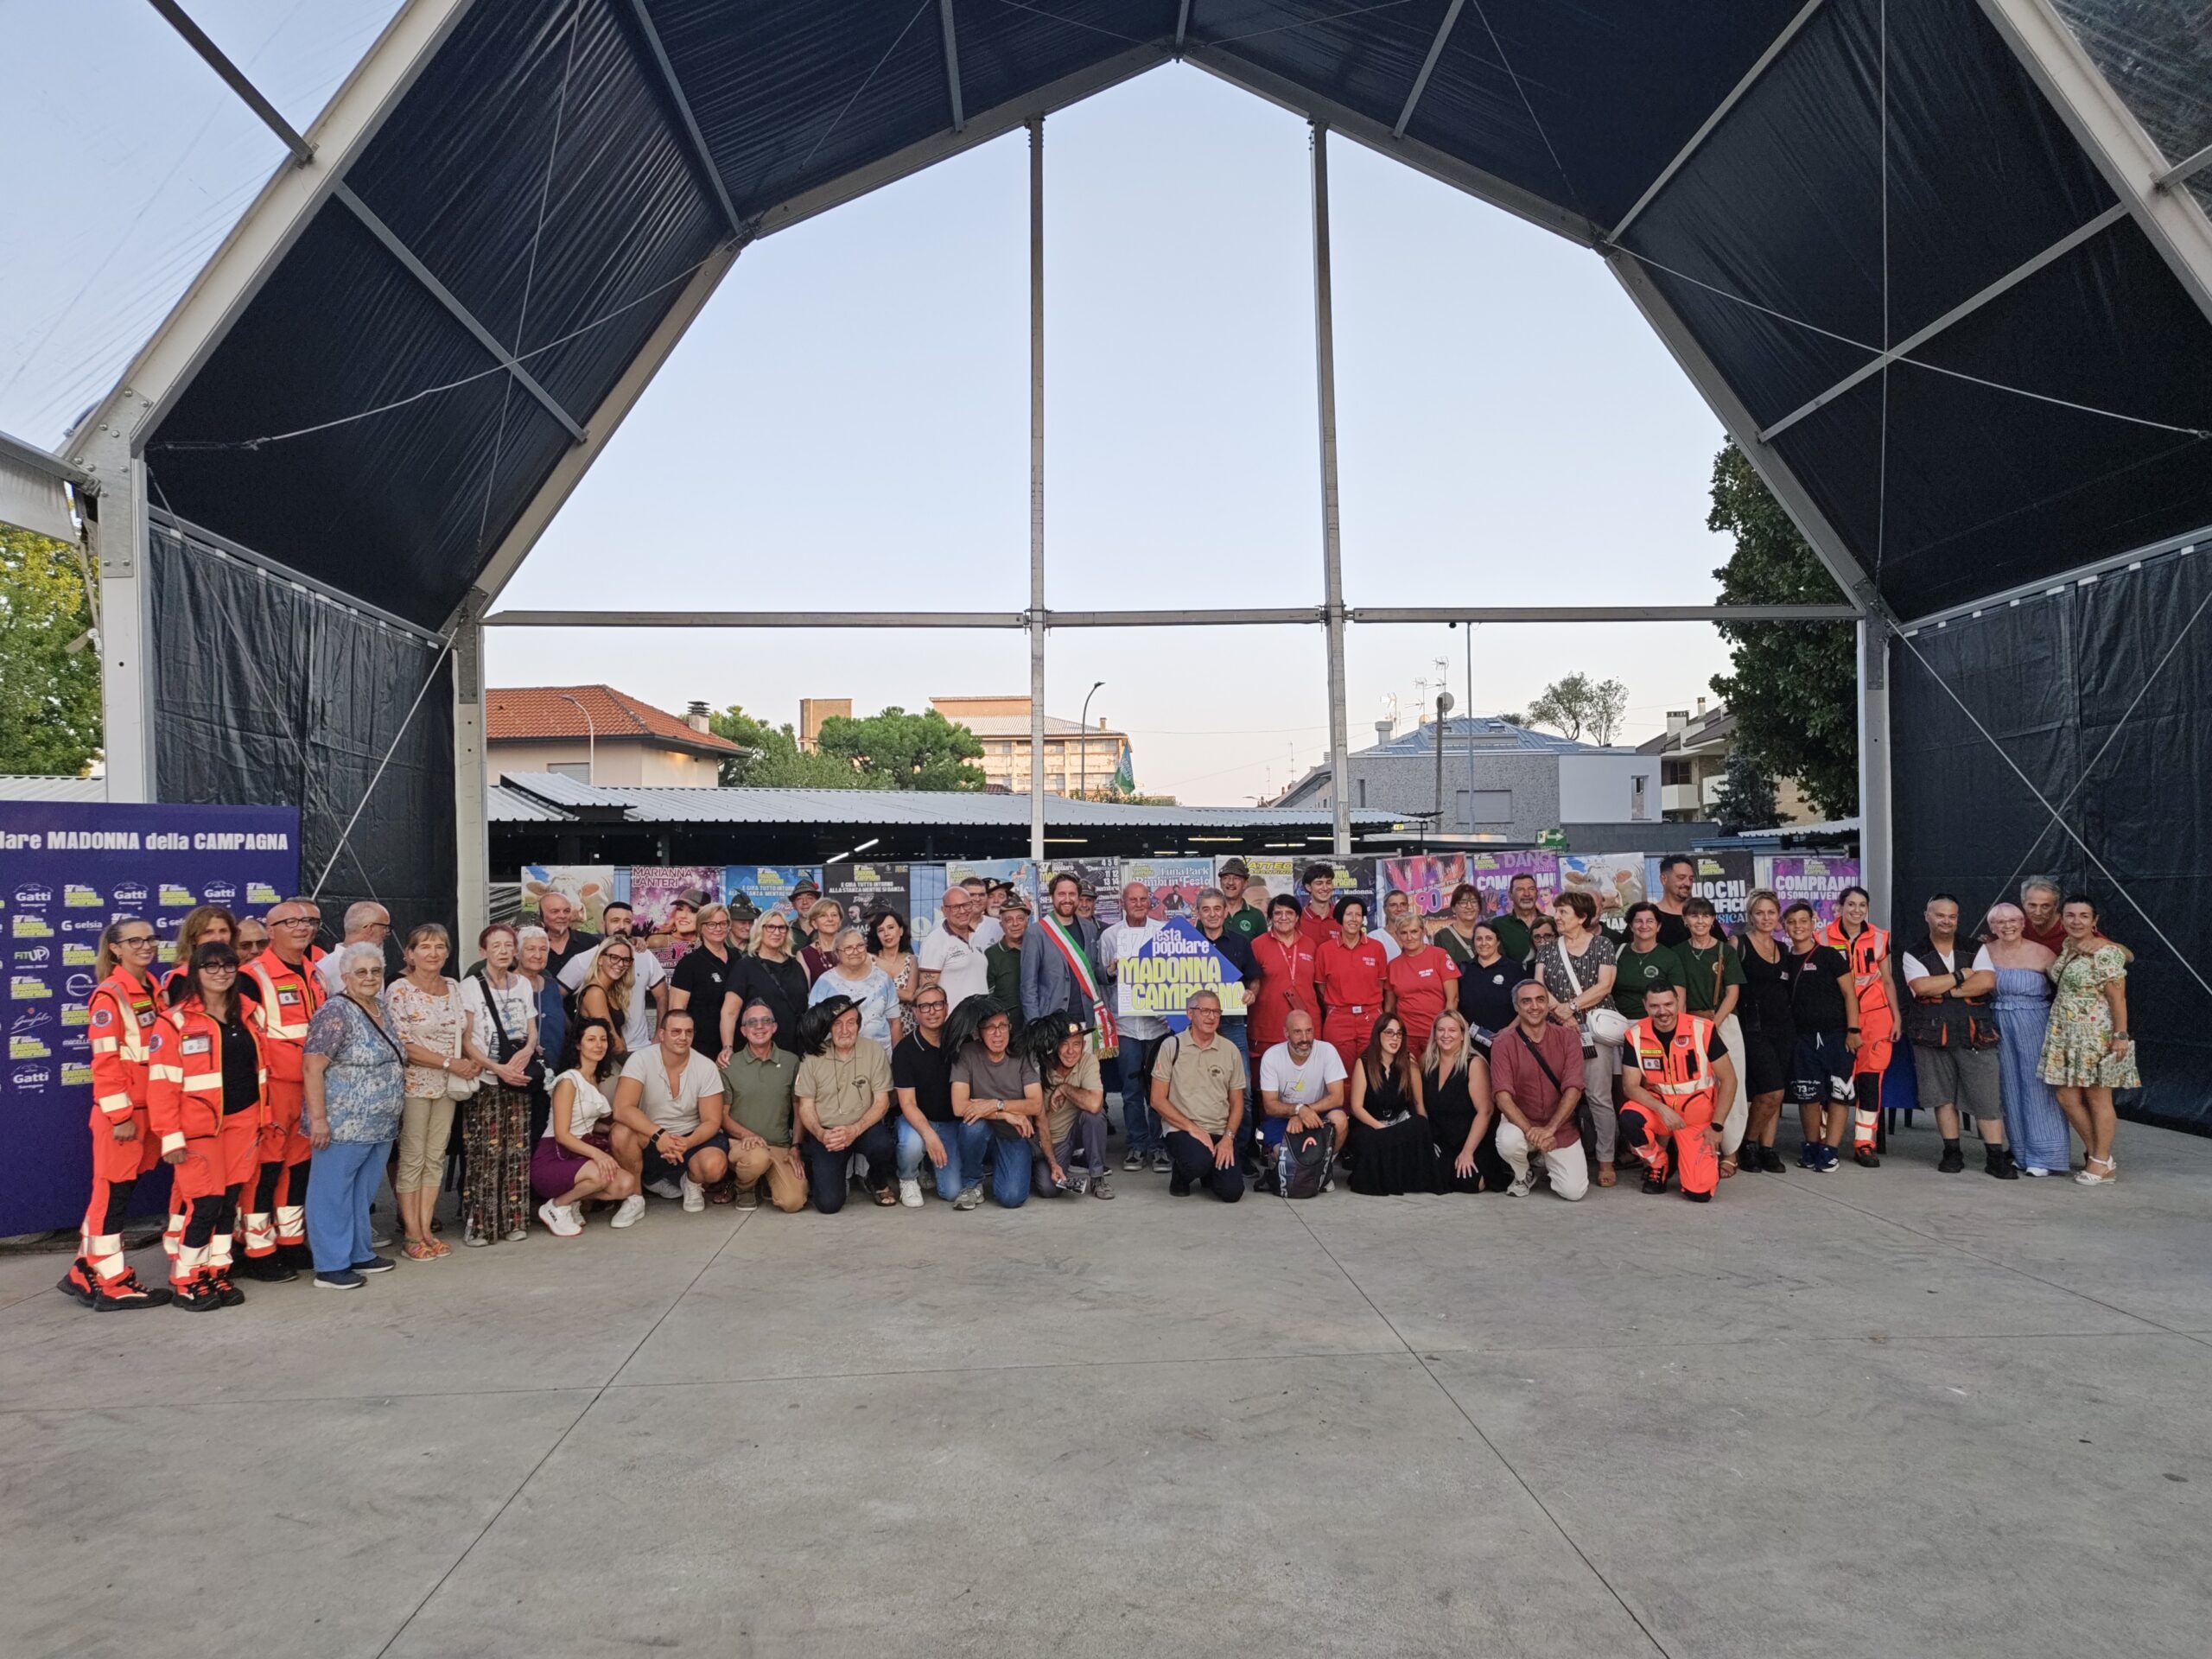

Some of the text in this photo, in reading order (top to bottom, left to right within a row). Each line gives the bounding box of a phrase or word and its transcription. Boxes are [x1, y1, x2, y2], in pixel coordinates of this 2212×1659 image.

[48, 831, 140, 849] MADONNA
[145, 833, 189, 850] della
[194, 833, 288, 850] CAMPAGNA
[1504, 851, 1555, 868] DANCE
[632, 867, 692, 878] MARIANNA
[632, 878, 678, 887] LANTERI
[1692, 880, 1745, 899] UOCHI
[16, 892, 52, 901] Gatti
[113, 890, 147, 899] Gatti
[204, 888, 236, 898] Gatti
[1414, 887, 1441, 916] 90
[1152, 938, 1210, 957] popolare
[1118, 957, 1221, 983] MADONNA
[1131, 982, 1246, 1010] CAMPNA
[13, 1072, 48, 1083] Gatti
